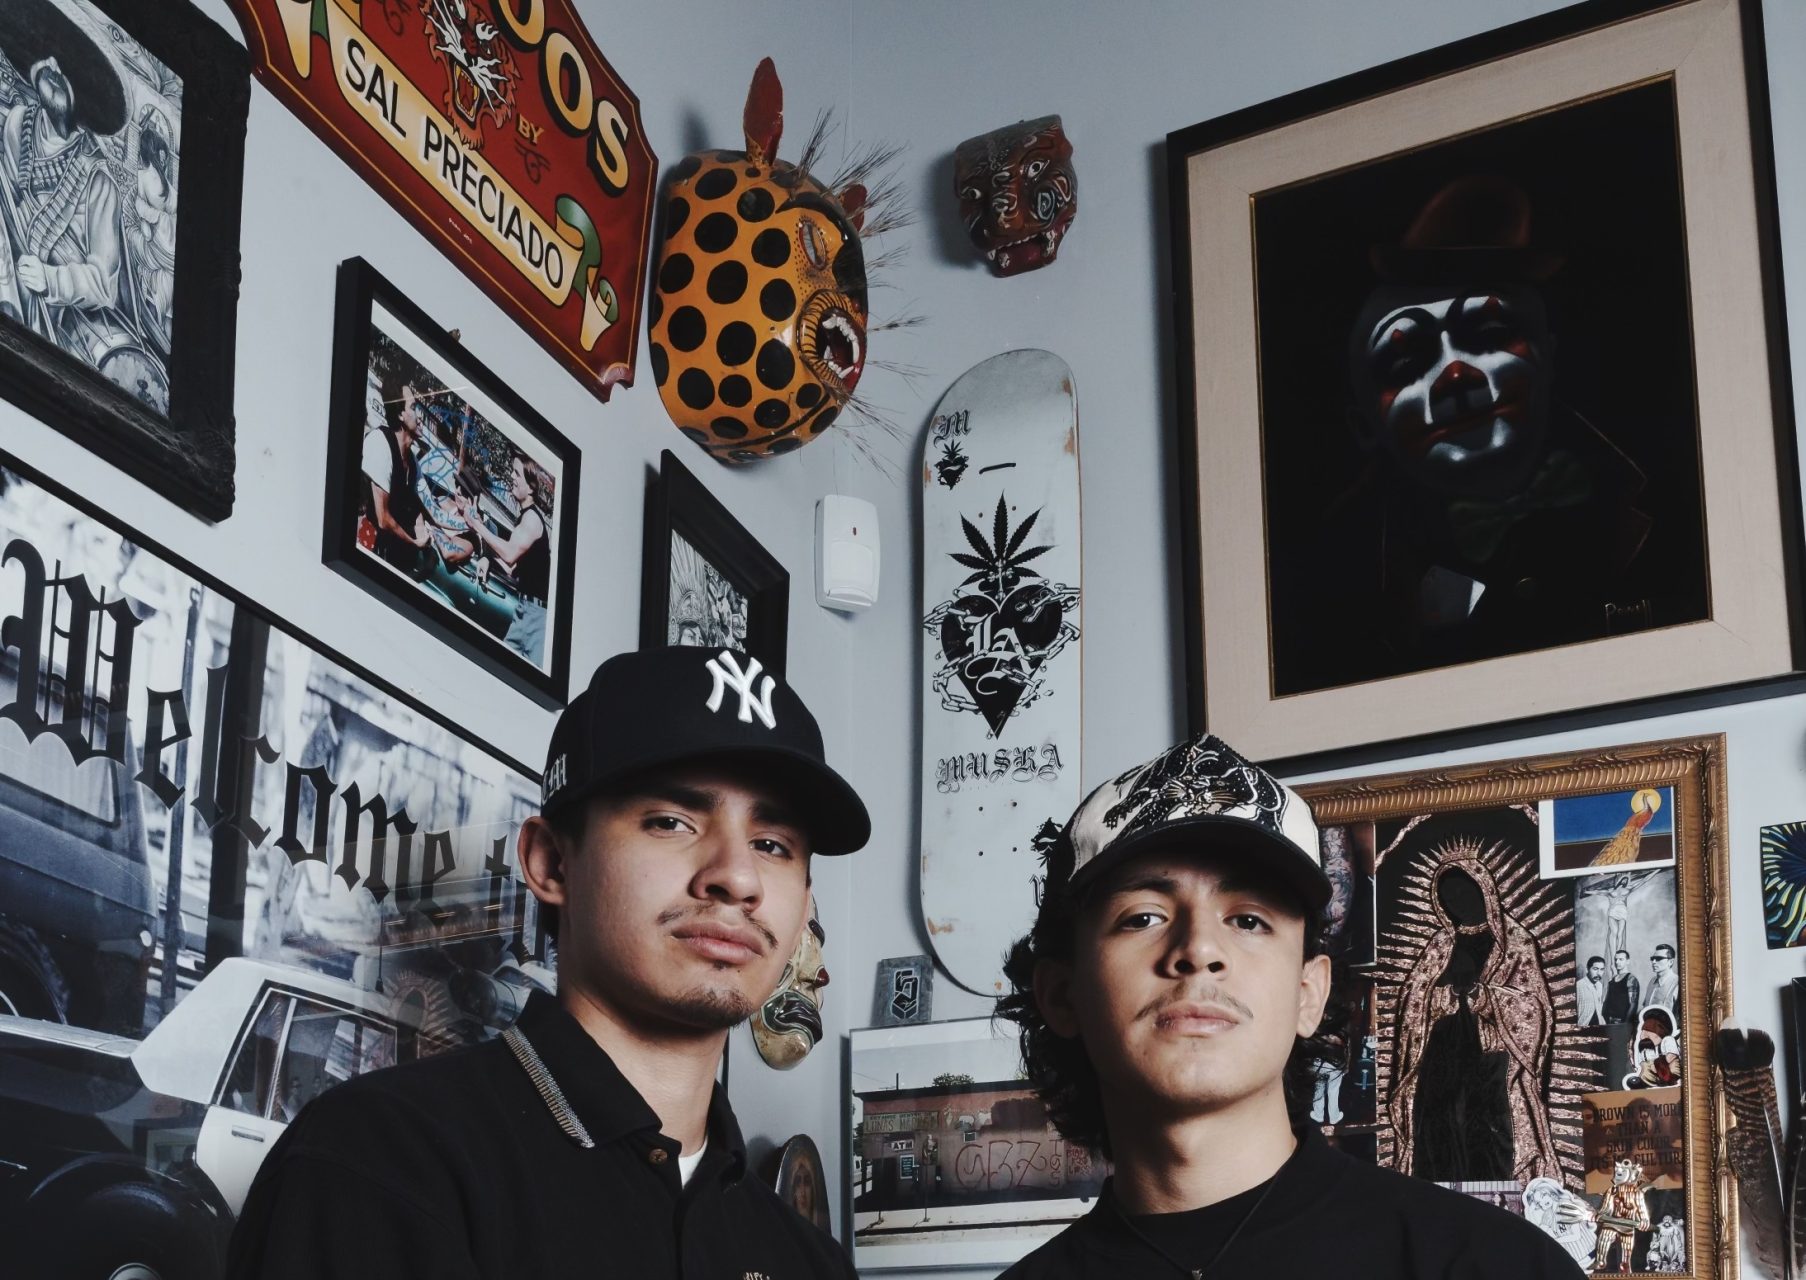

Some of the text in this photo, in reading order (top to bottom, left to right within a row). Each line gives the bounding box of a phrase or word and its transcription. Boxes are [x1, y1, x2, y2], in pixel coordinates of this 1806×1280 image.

[517, 113, 545, 145] BY
[344, 38, 564, 290] SAL PRECIADO
[705, 650, 777, 730] NY
[0, 538, 457, 927] Welcome
[934, 743, 1064, 794] MUSKA
[893, 1140, 913, 1150] ATM
[1607, 1135, 1670, 1153] SKIN COLOR
